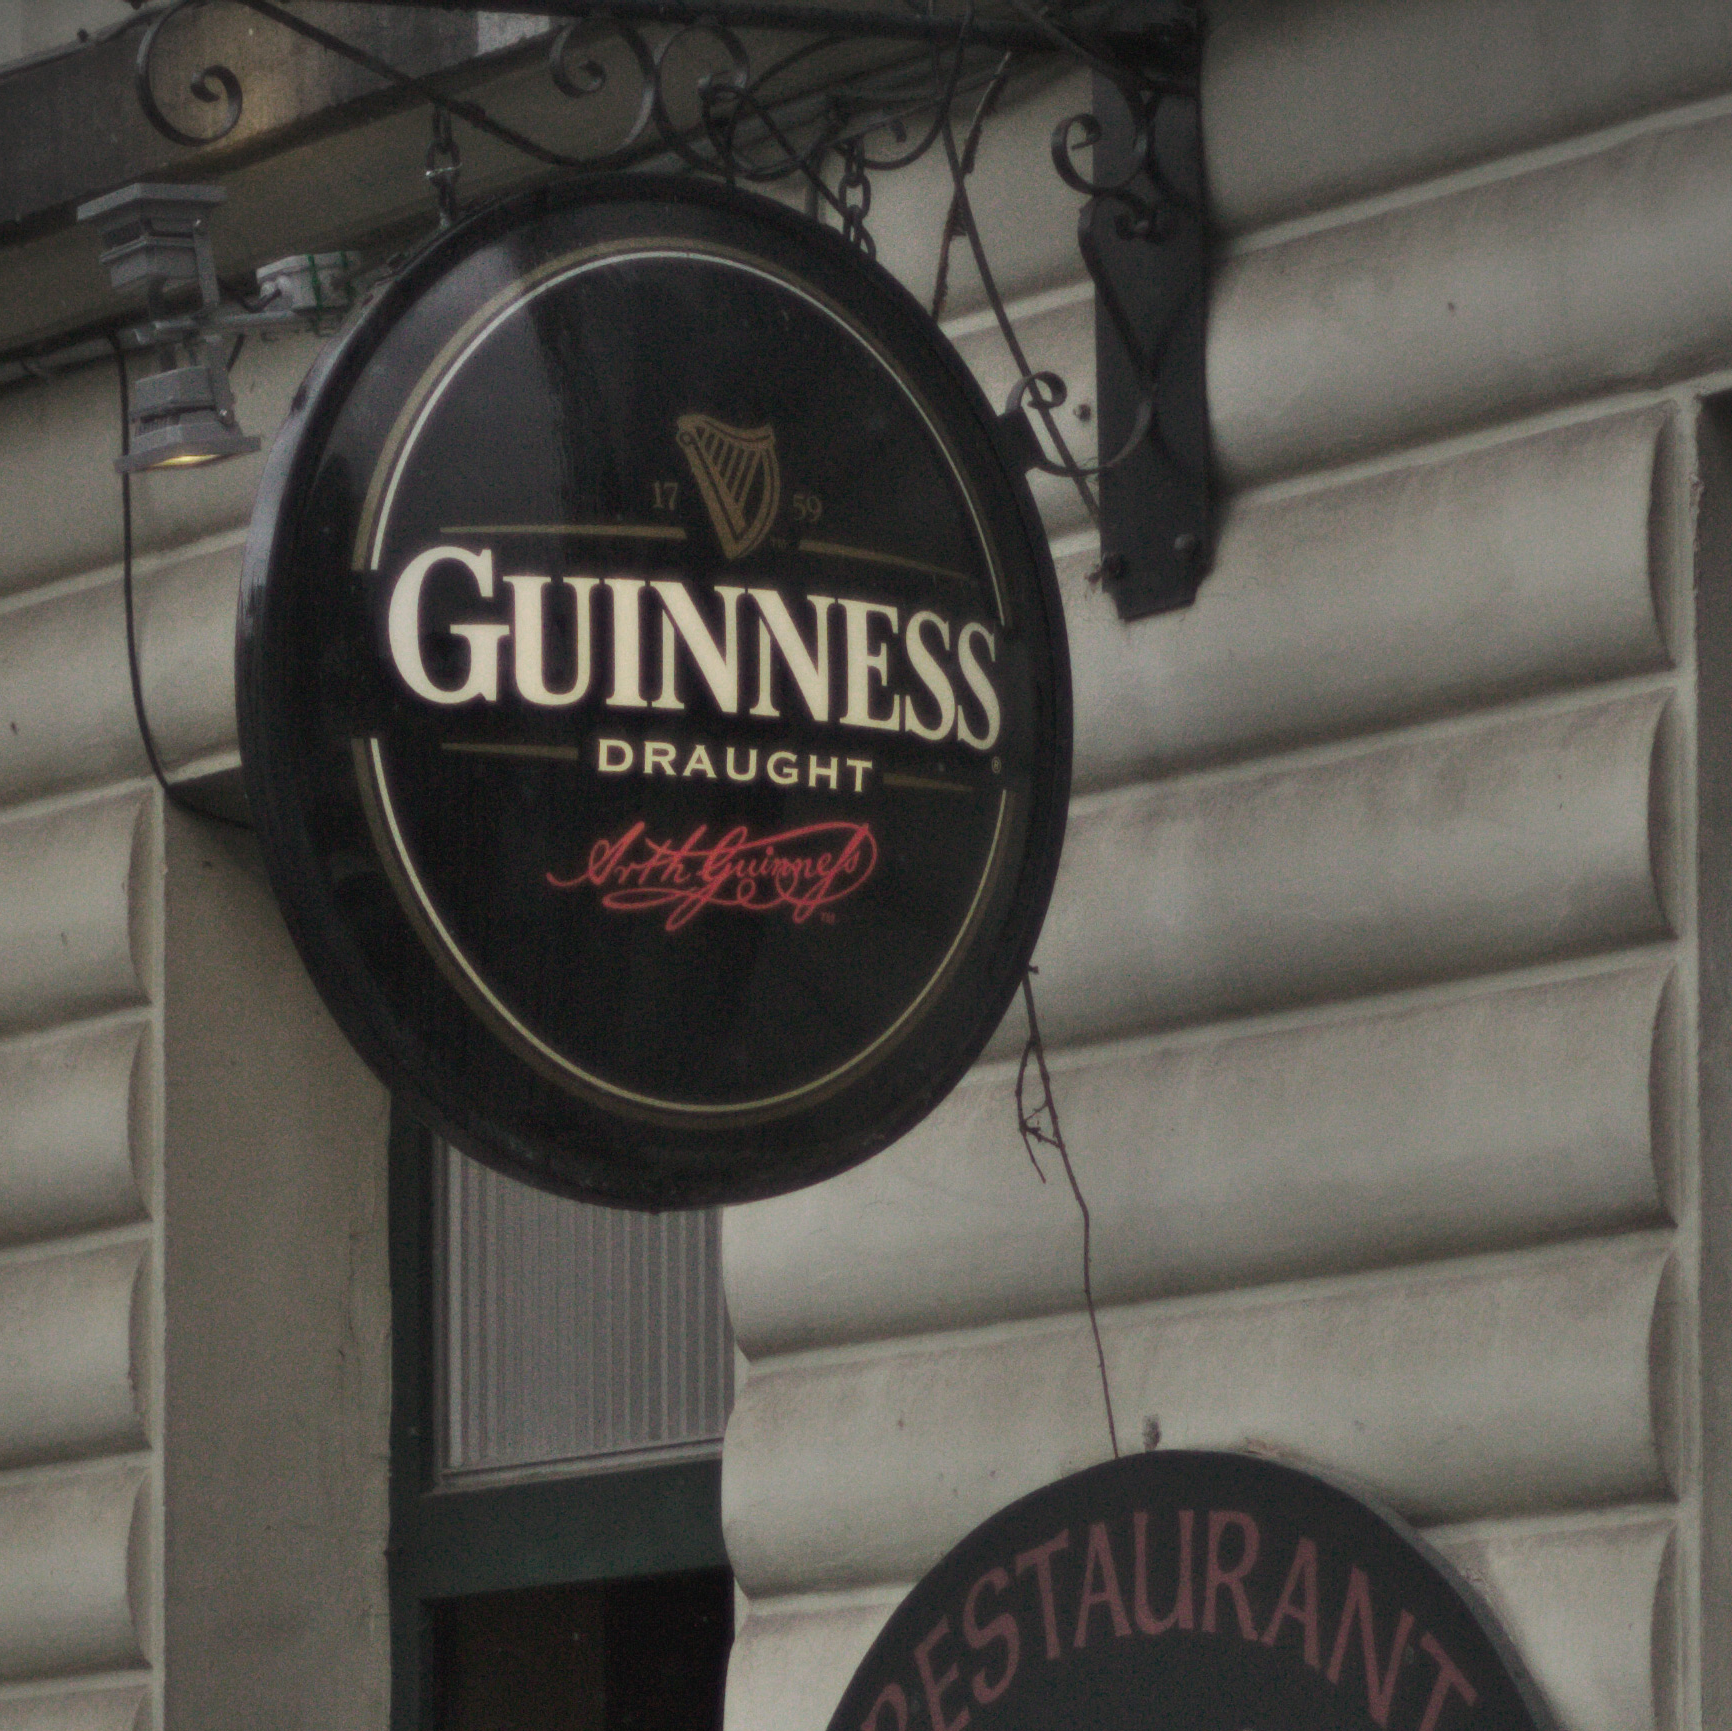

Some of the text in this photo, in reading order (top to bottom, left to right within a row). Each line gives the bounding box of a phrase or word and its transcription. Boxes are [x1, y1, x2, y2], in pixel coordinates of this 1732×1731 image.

[651, 480, 679, 511] 17
[792, 493, 823, 523] 59
[387, 544, 1002, 750] GUINNESS
[597, 737, 874, 794] DRAUGHT
